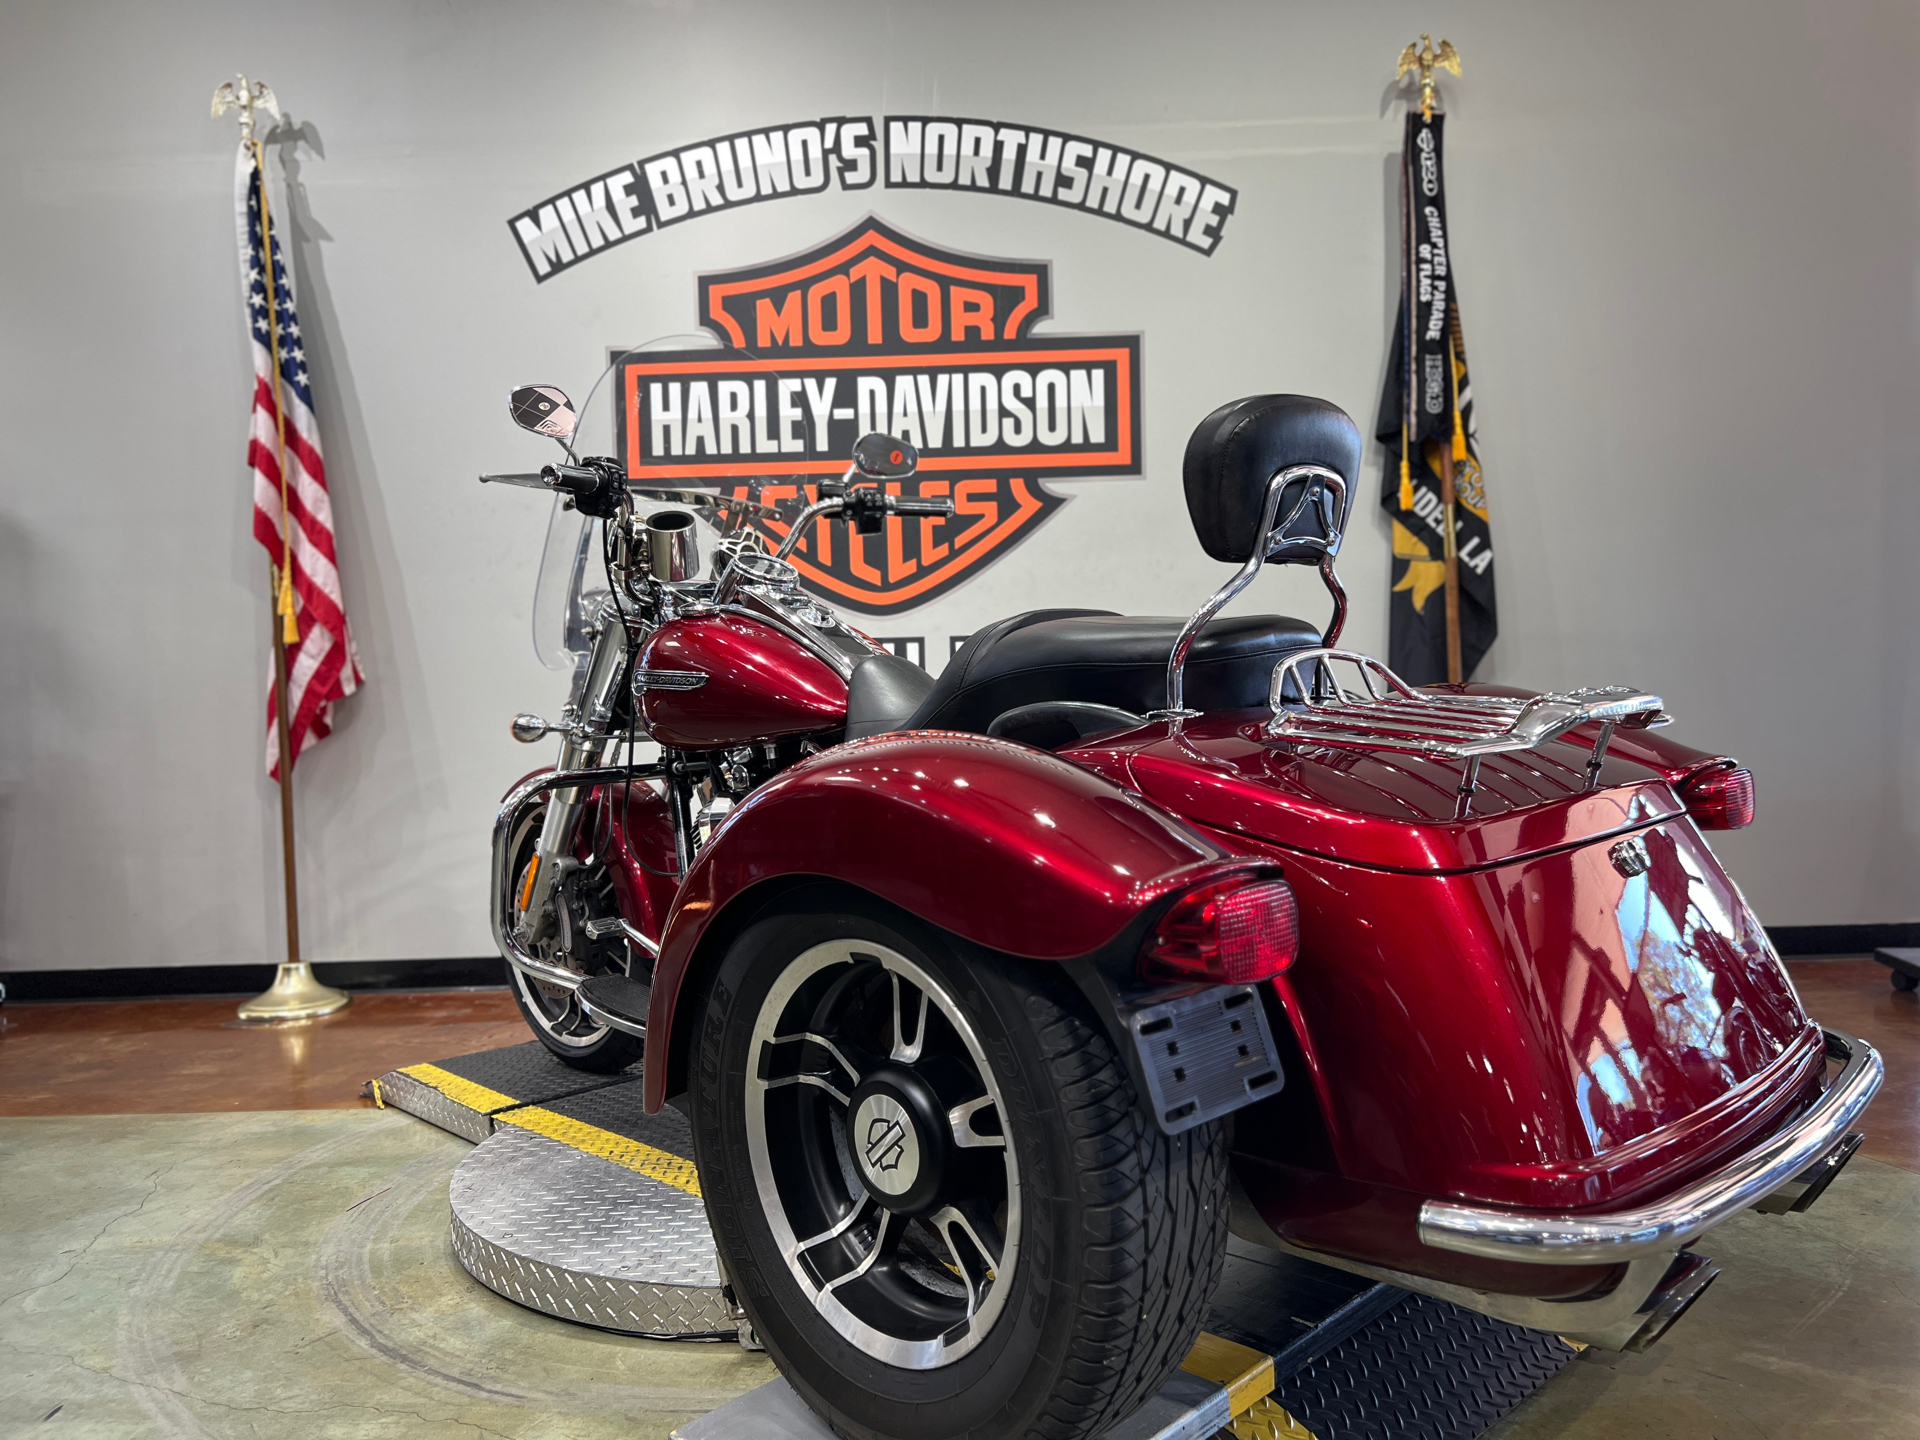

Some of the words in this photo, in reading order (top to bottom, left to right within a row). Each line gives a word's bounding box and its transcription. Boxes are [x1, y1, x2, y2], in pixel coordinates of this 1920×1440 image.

[514, 170, 648, 277] MIKE
[643, 121, 871, 223] BRUNO'S
[889, 120, 1232, 250] NORTHSHORE
[1418, 243, 1432, 261] OF
[1424, 205, 1447, 277] CHAPTER
[756, 256, 995, 348] MOTOR
[1419, 263, 1432, 303] FLAGS
[1425, 279, 1447, 341] PARADE
[649, 368, 1106, 458] HARLEY-DAVIDSON
[1458, 535, 1494, 576] LA
[637, 674, 699, 685] HARLEY-DAVIDSON
[700, 976, 770, 1298] SIGNATURE
[988, 1036, 1050, 1328] DUNLOP
